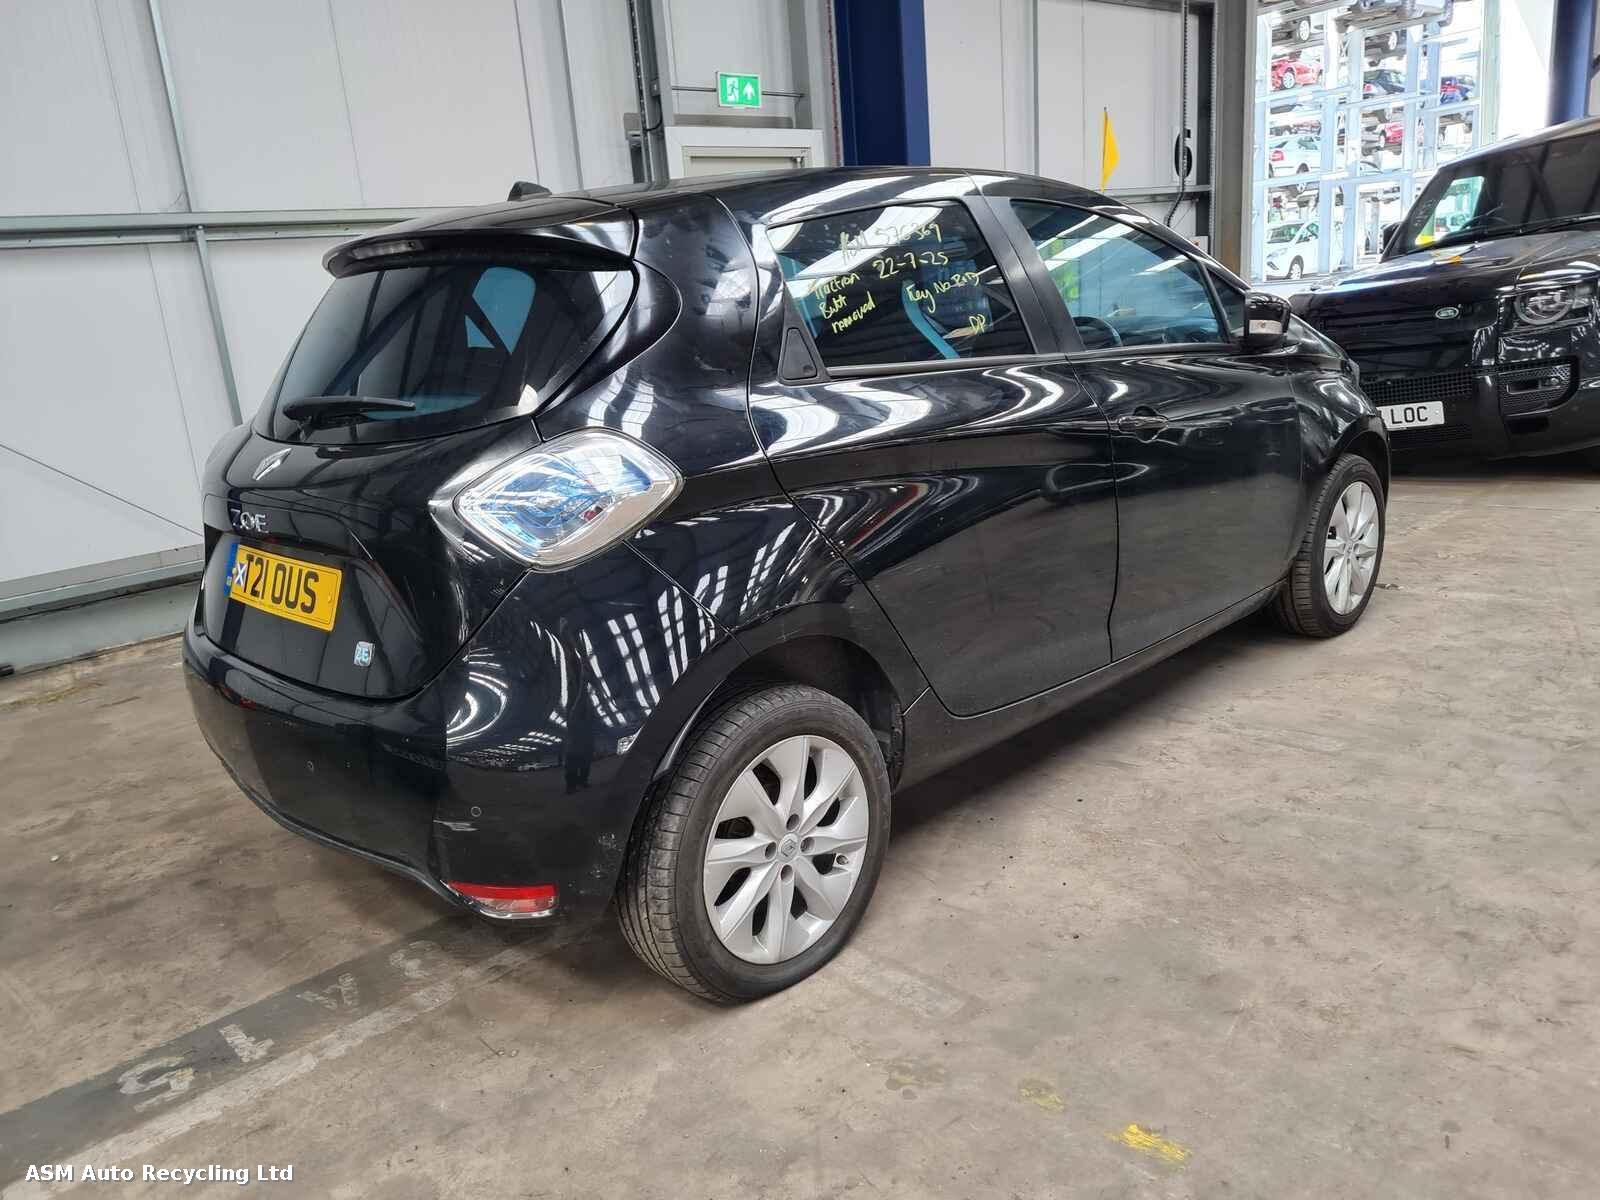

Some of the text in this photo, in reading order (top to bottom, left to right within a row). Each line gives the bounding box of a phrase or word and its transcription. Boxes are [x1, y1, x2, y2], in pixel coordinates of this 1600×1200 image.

[872, 251, 949, 279] 22-7-25
[831, 290, 876, 334] removed
[906, 283, 936, 314] Key
[1390, 406, 1429, 425] LOC
[270, 564, 320, 614] OUS
